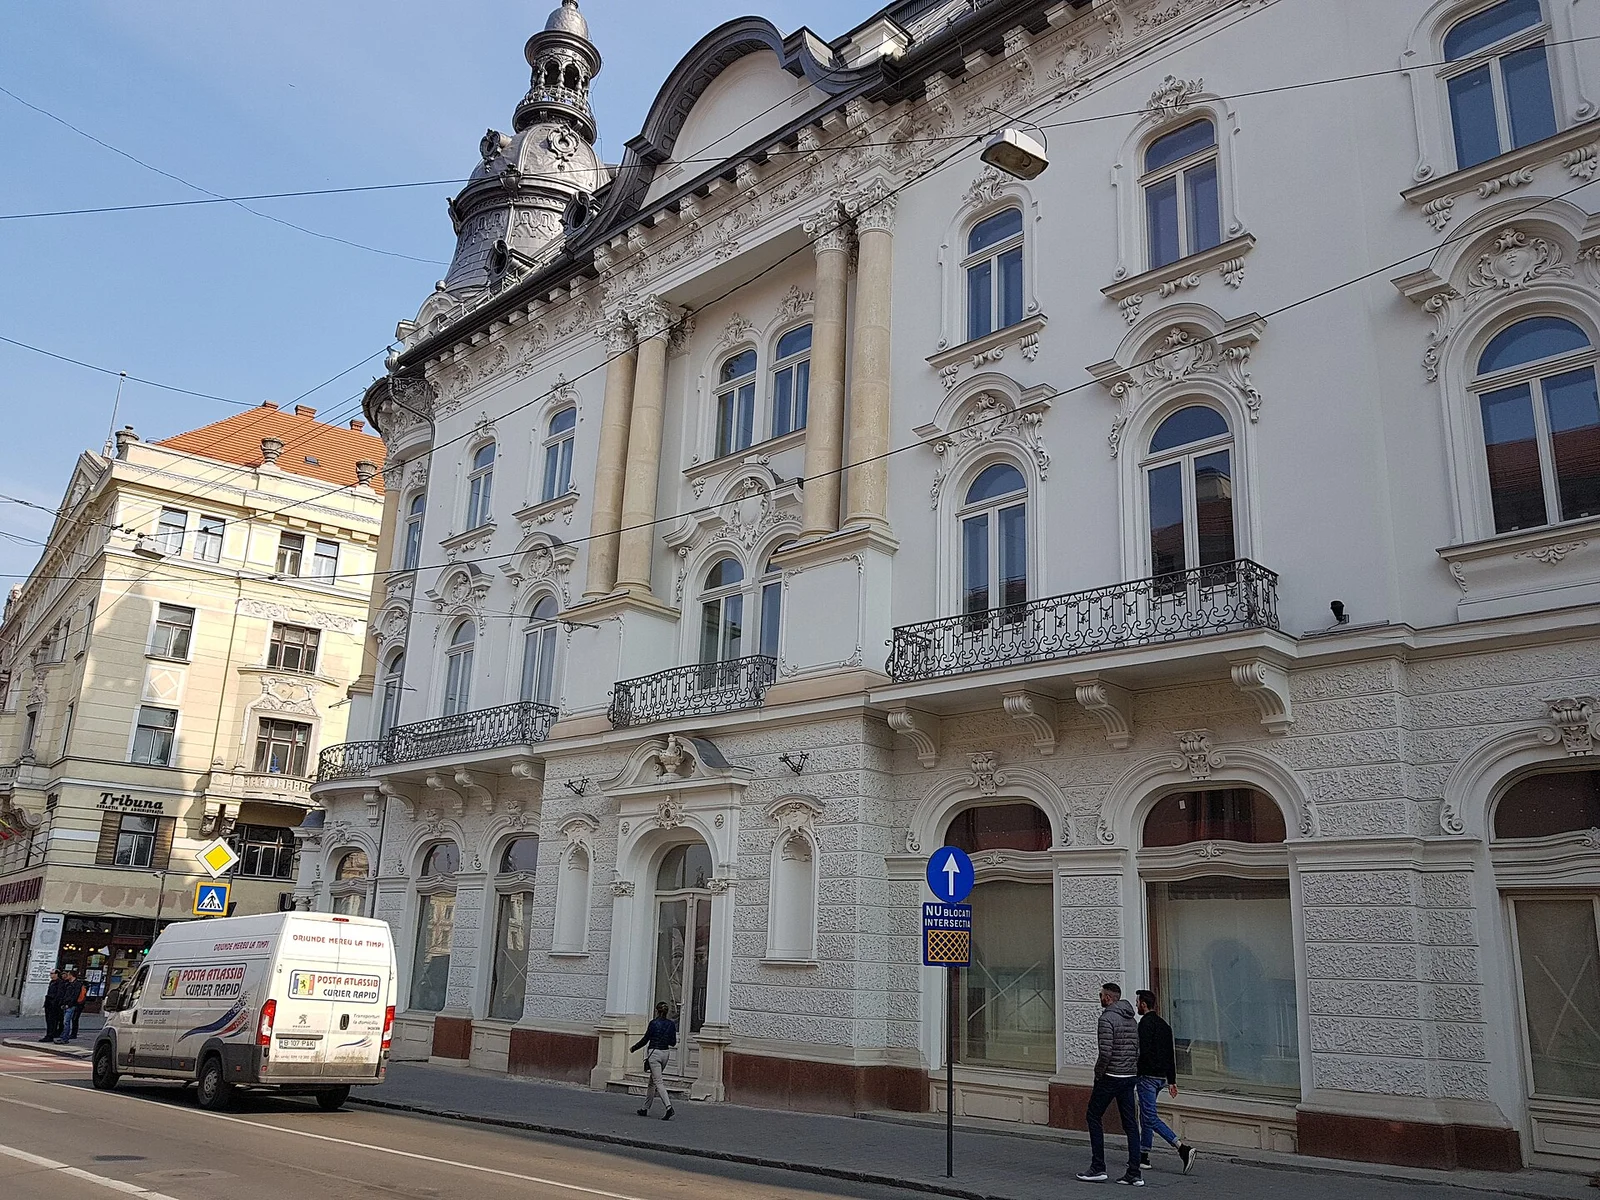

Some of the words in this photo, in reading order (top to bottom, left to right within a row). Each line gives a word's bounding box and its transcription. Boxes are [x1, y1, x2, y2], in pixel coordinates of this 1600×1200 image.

[100, 792, 163, 810] Tribuna
[926, 904, 942, 916] NU
[249, 941, 257, 949] LA
[292, 934, 326, 944] ORIUNDE
[328, 937, 353, 946] MEREU
[181, 969, 207, 981] POSTA
[206, 967, 244, 981] ATLASSIB
[317, 975, 342, 985] POSTA
[343, 977, 379, 987] ATLASSIB
[185, 983, 213, 997] CURIER
[213, 983, 240, 996] RAPID
[323, 988, 351, 998] CURIER
[352, 990, 377, 999] RAPID
